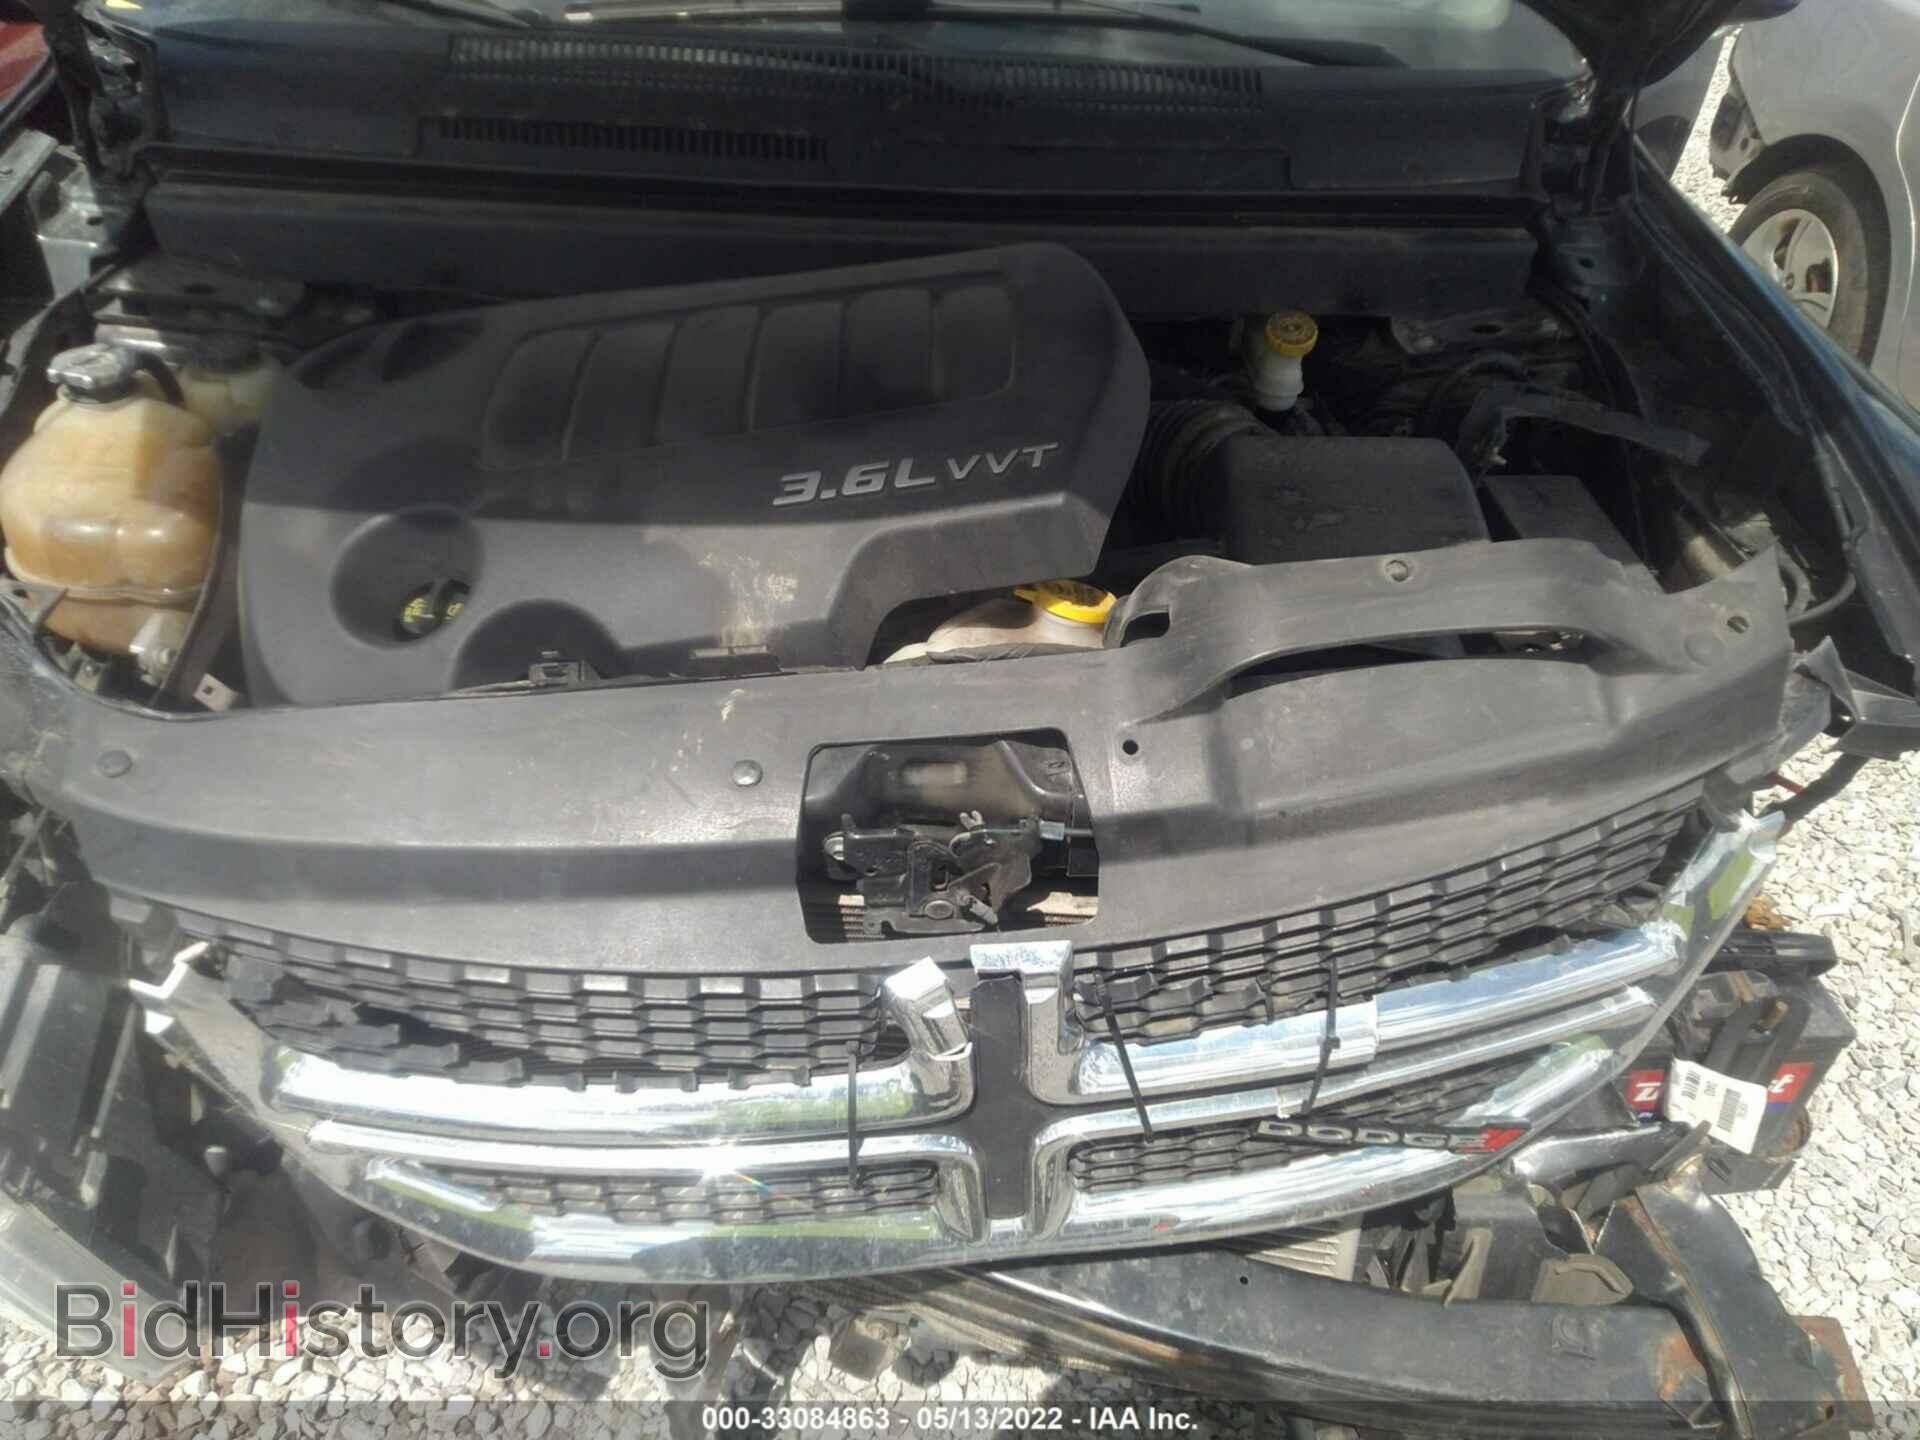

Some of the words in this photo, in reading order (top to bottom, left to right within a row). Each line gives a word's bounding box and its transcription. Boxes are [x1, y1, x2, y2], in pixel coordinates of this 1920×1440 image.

[772, 457, 936, 506] 3.6L
[945, 442, 1060, 480] VVT
[1256, 1119, 1490, 1153] DODGE
